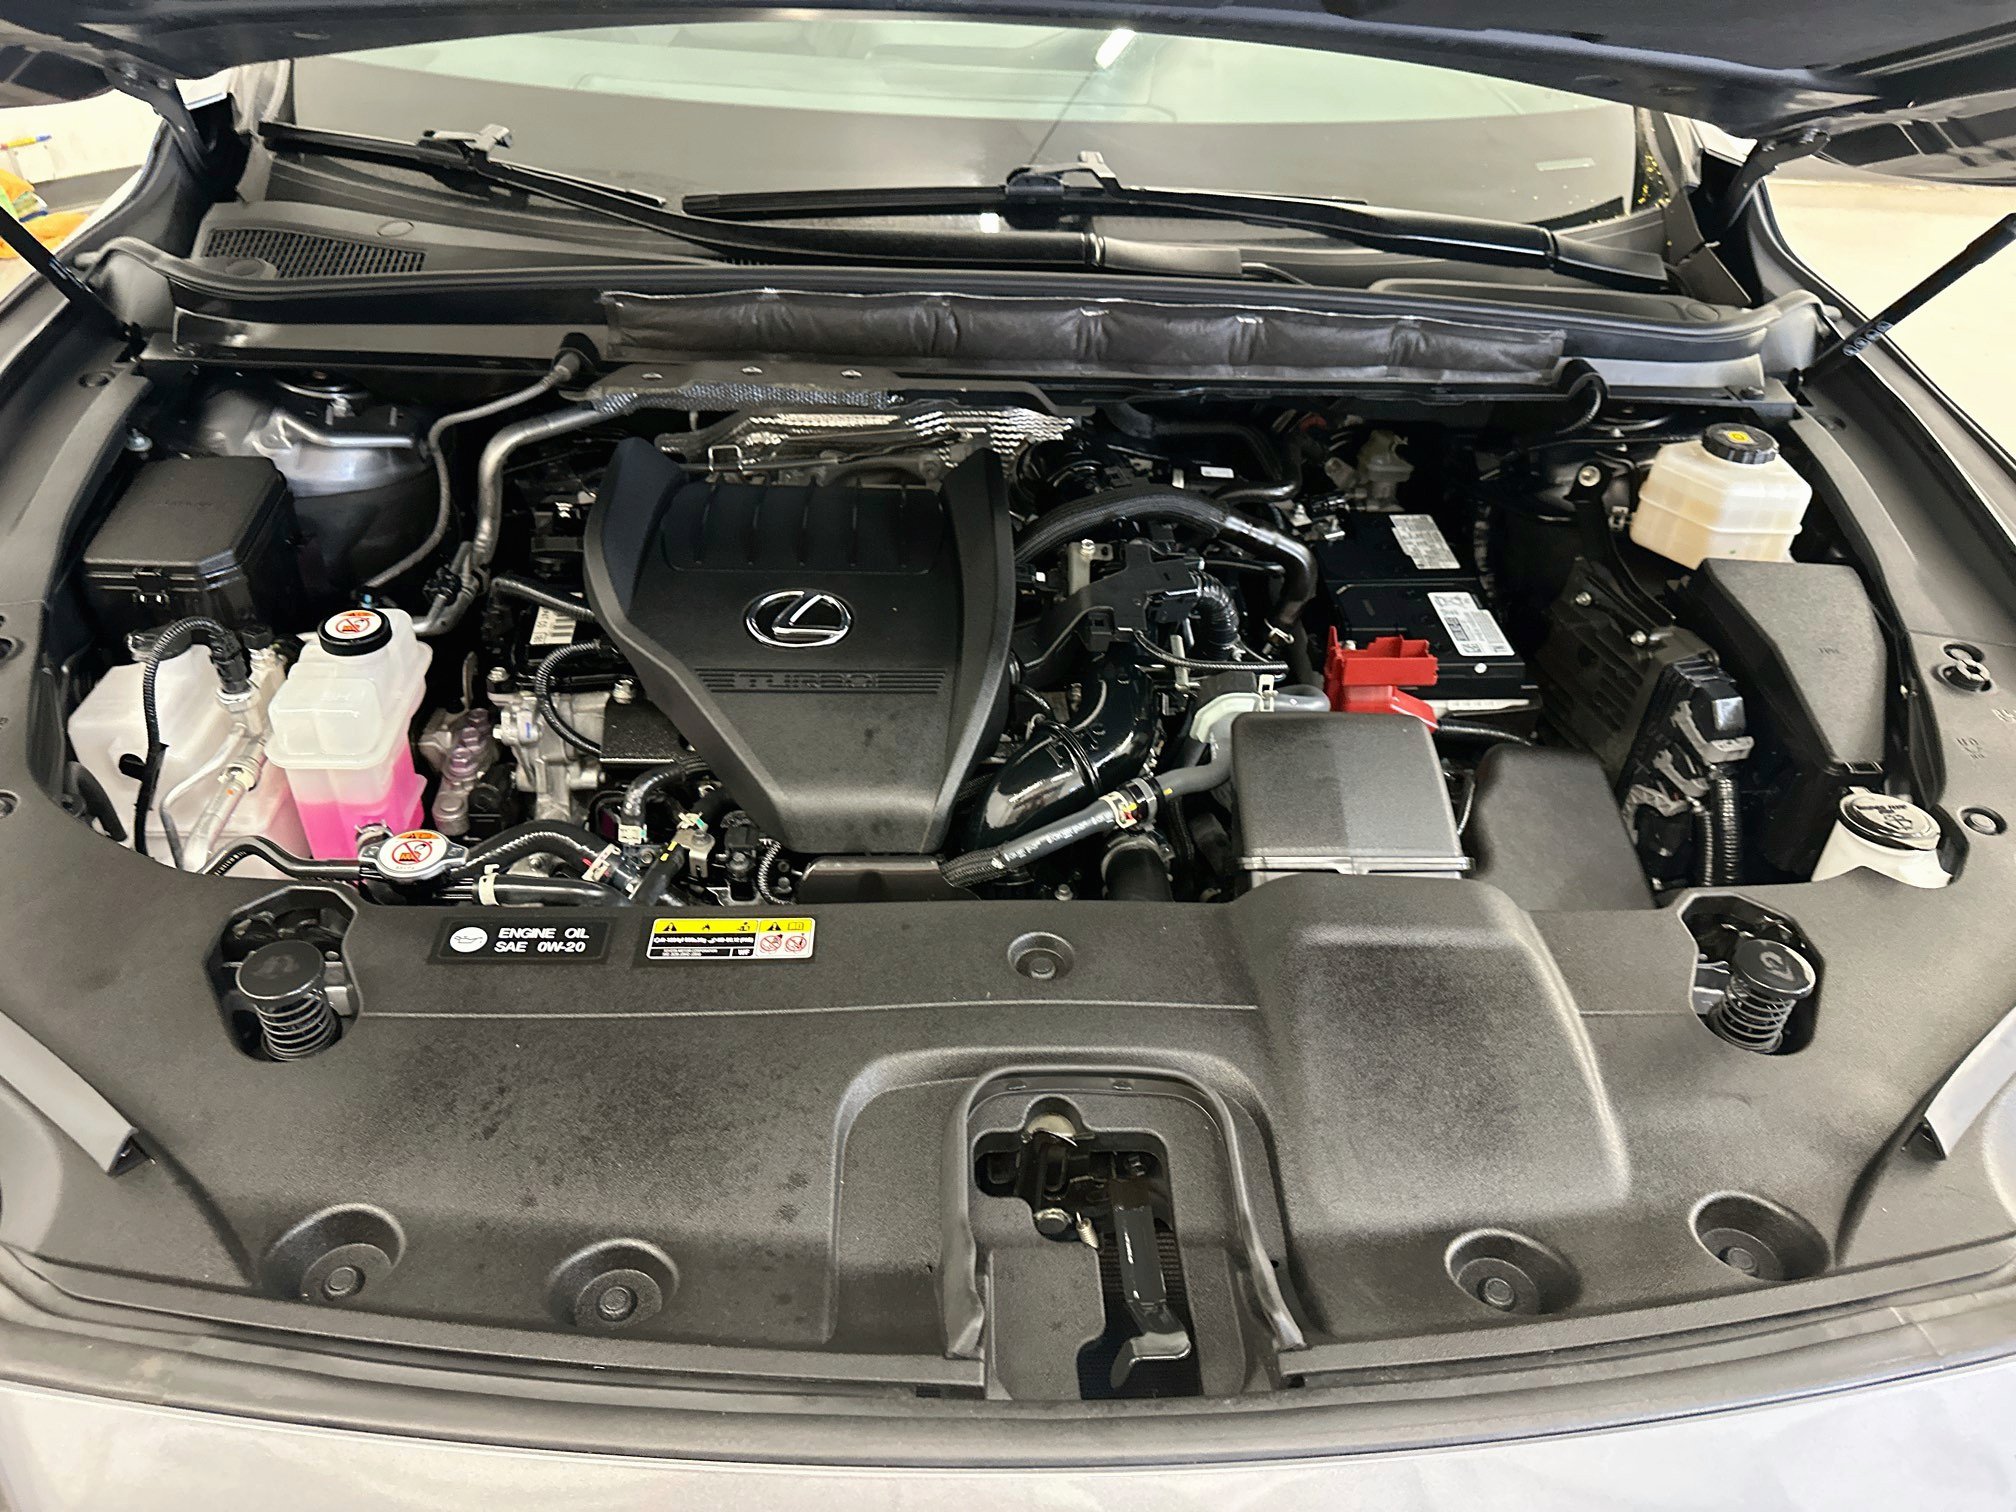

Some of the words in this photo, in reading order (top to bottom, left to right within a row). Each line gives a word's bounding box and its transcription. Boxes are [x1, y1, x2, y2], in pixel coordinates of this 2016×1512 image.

[735, 671, 876, 690] TURBO
[498, 927, 557, 939] ENGINE
[564, 927, 590, 939] OIL
[494, 941, 528, 953] SAE
[537, 941, 586, 953] 0W-20
